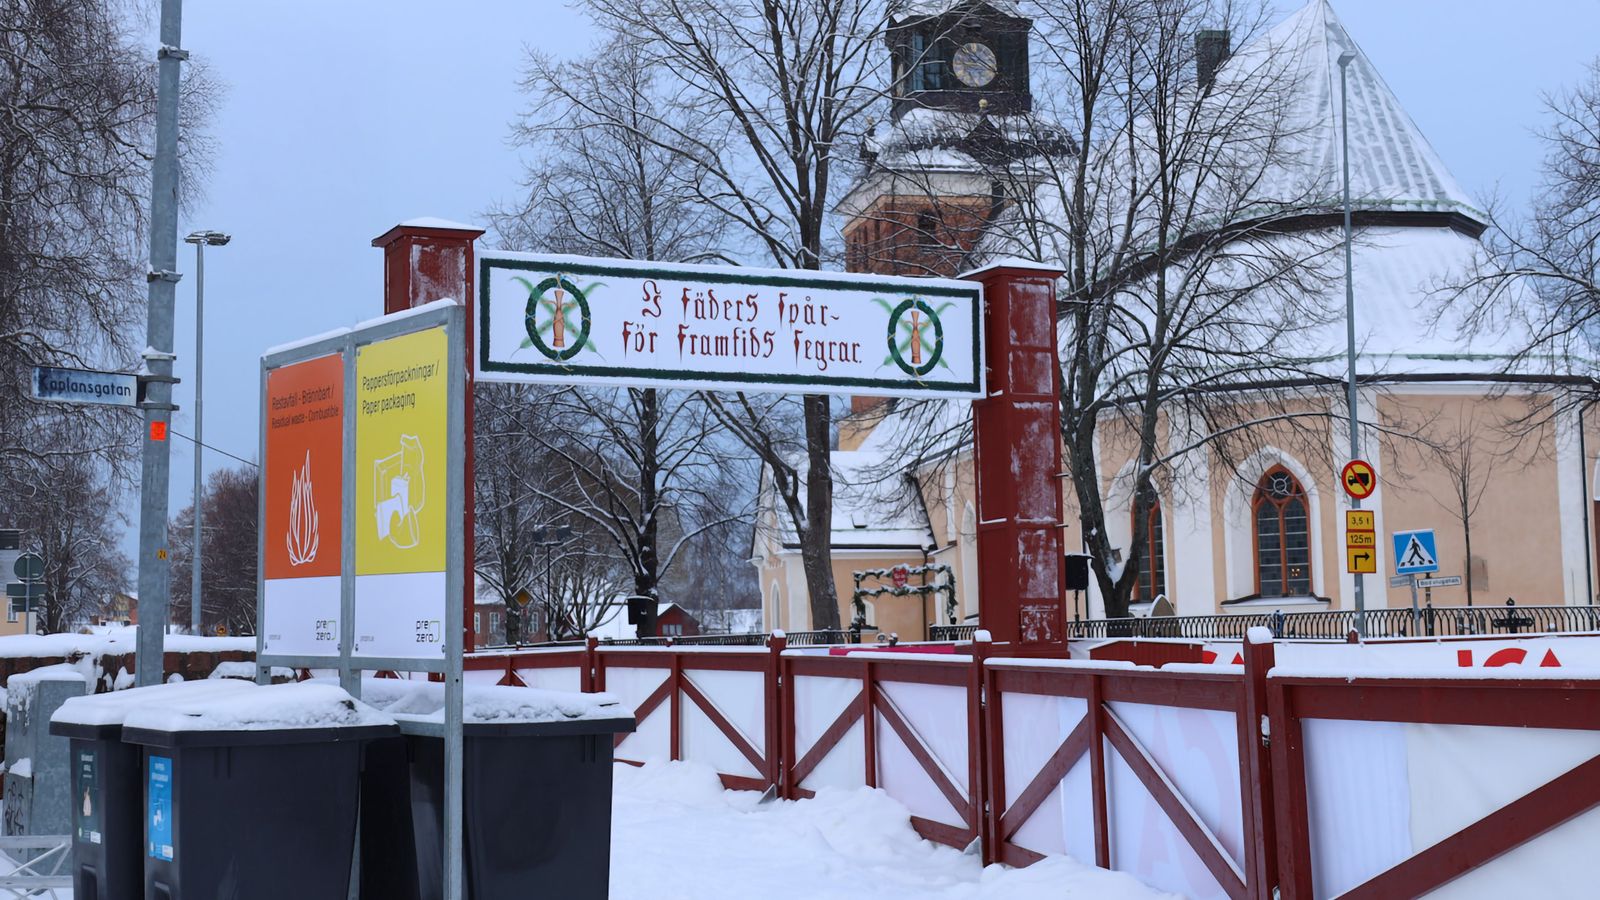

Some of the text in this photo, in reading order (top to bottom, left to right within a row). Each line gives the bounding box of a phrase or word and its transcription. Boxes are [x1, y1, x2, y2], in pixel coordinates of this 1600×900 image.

[39, 375, 131, 397] Kaplansgatan
[362, 363, 435, 393] Pappersförpackningar
[271, 391, 297, 410] Restavfall
[302, 385, 330, 405] Brännbart
[362, 392, 416, 416] Paper packaging
[271, 414, 290, 430] Residual
[291, 412, 304, 425] waste
[308, 405, 339, 422] Combustible
[1351, 516, 1364, 526] 3,5
[315, 619, 328, 630] pre
[415, 619, 430, 631] pre
[315, 632, 331, 641] zero
[415, 632, 434, 643] zero
